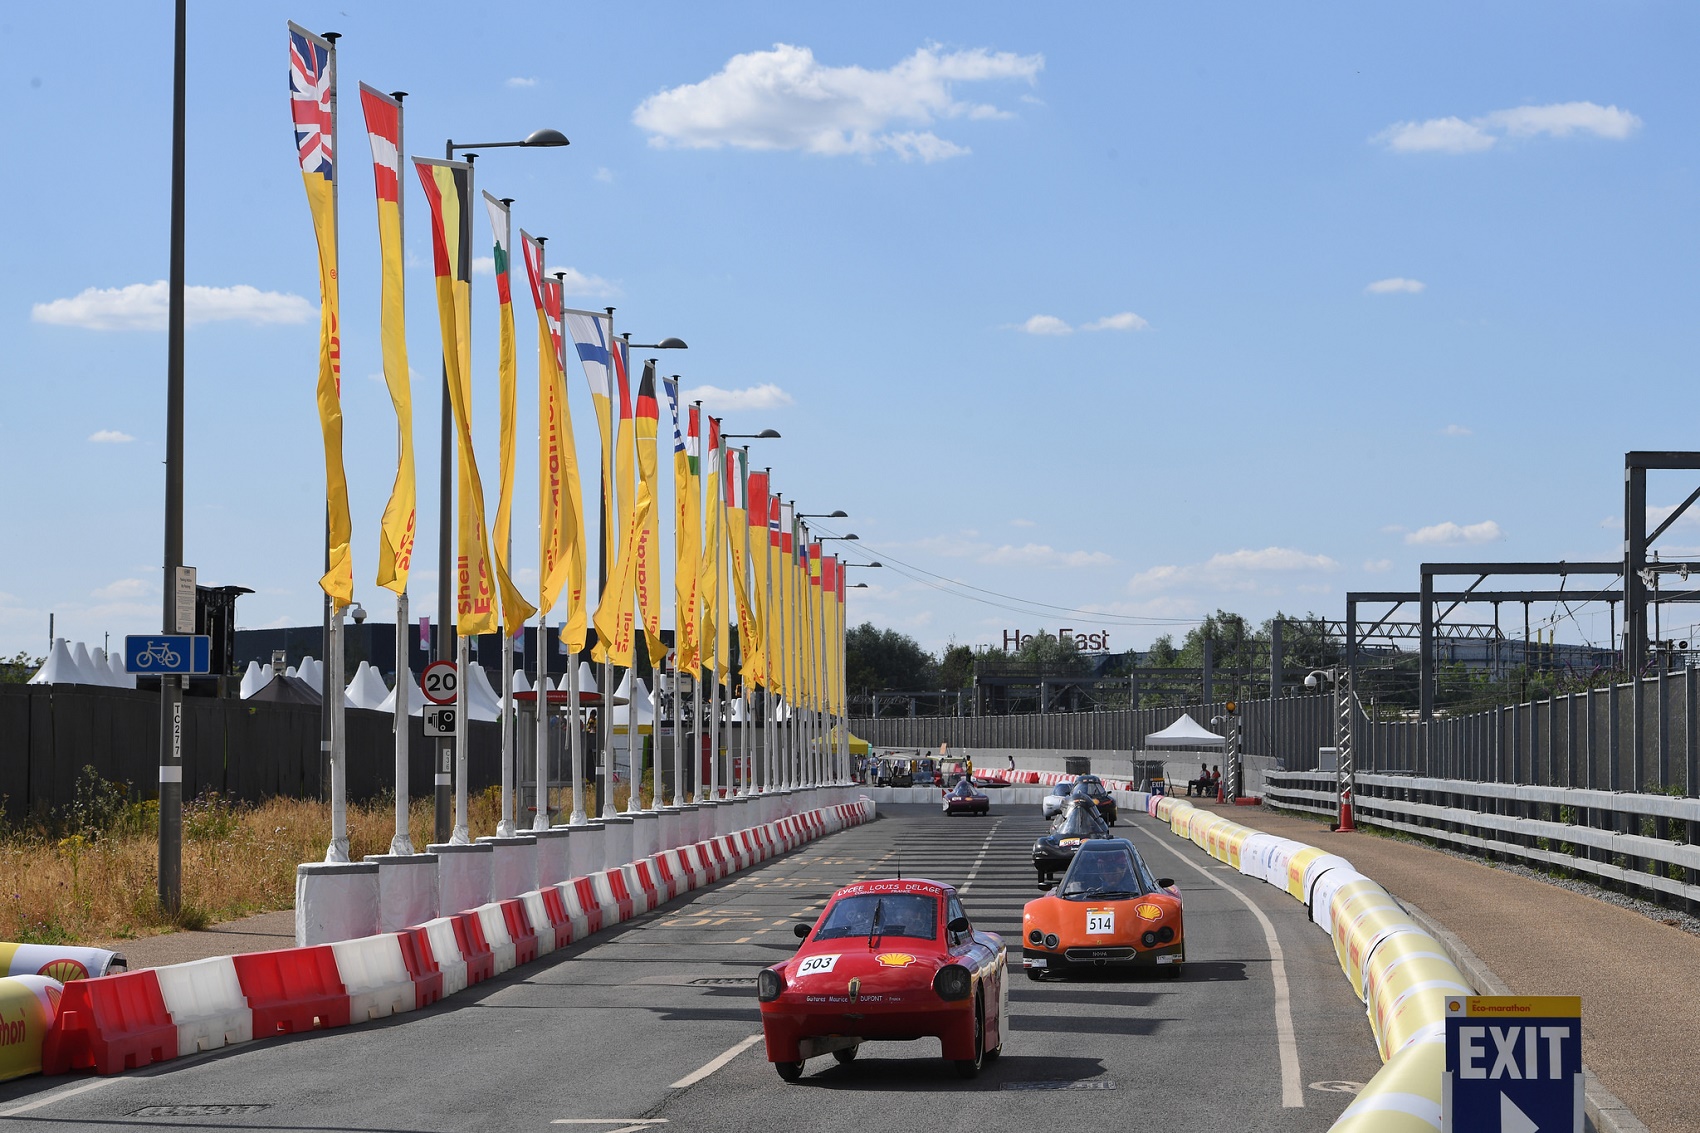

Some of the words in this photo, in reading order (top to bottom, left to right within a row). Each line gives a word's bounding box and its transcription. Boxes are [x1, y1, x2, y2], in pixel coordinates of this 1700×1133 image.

[457, 555, 482, 615] Shell
[426, 672, 457, 692] 20
[905, 883, 942, 895] DELAGE
[1089, 917, 1112, 930] 514
[802, 957, 833, 971] 503
[1472, 1004, 1531, 1012] Eco-marathon
[1459, 1026, 1571, 1080] EXIT
